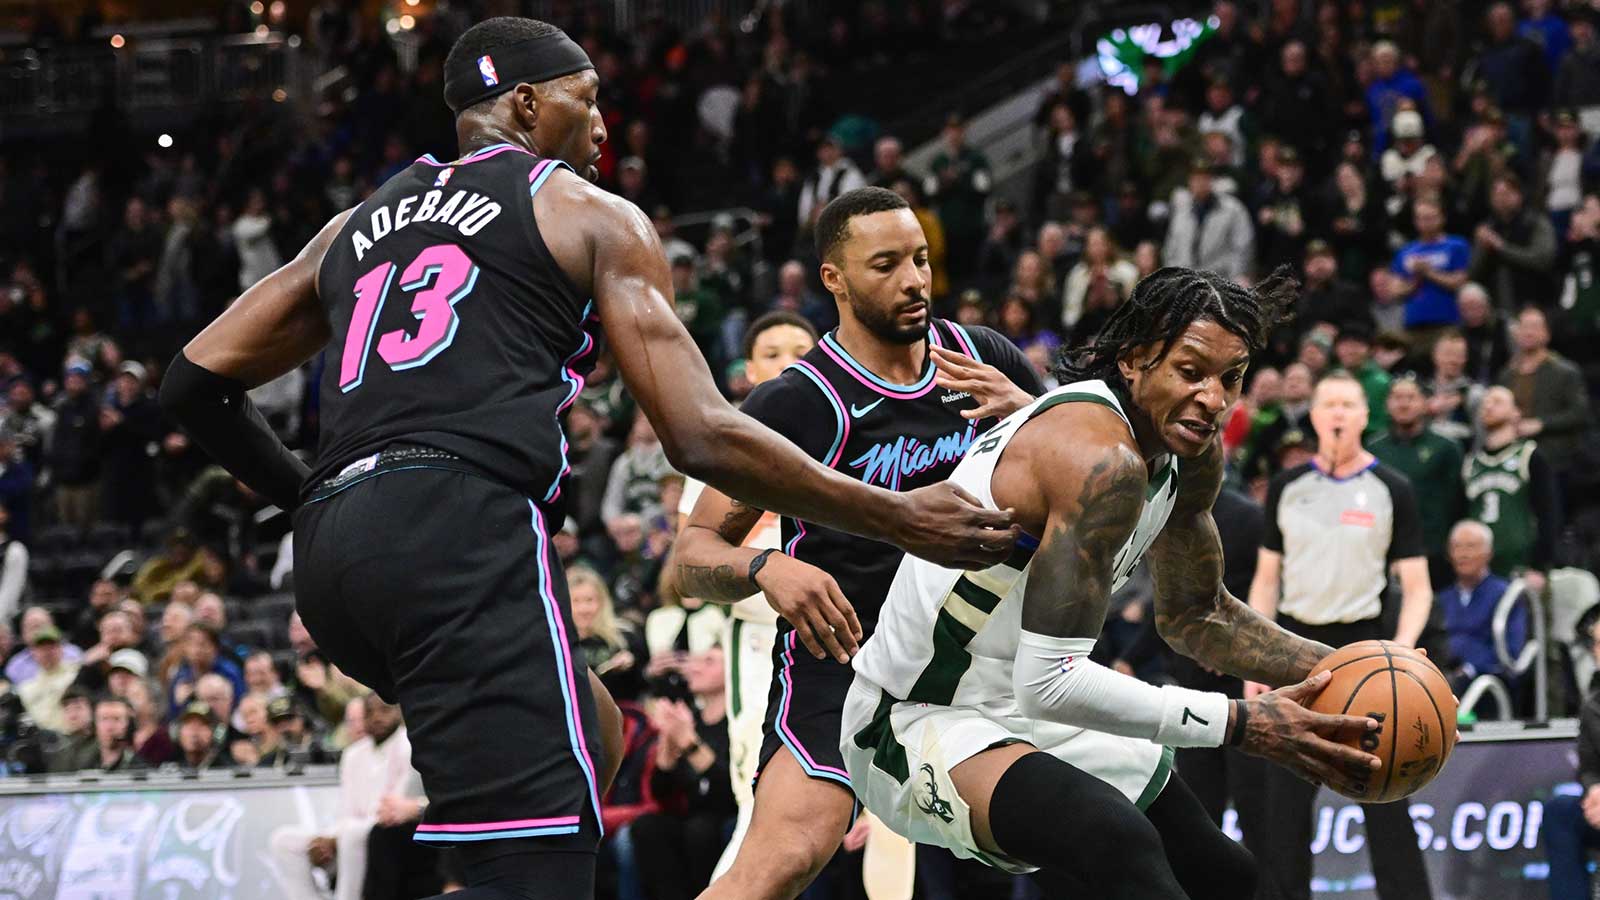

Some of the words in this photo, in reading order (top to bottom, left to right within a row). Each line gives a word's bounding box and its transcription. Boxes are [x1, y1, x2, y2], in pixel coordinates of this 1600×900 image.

[352, 190, 502, 262] ADEBAYO
[339, 243, 480, 394] 13
[849, 418, 982, 492] Miami
